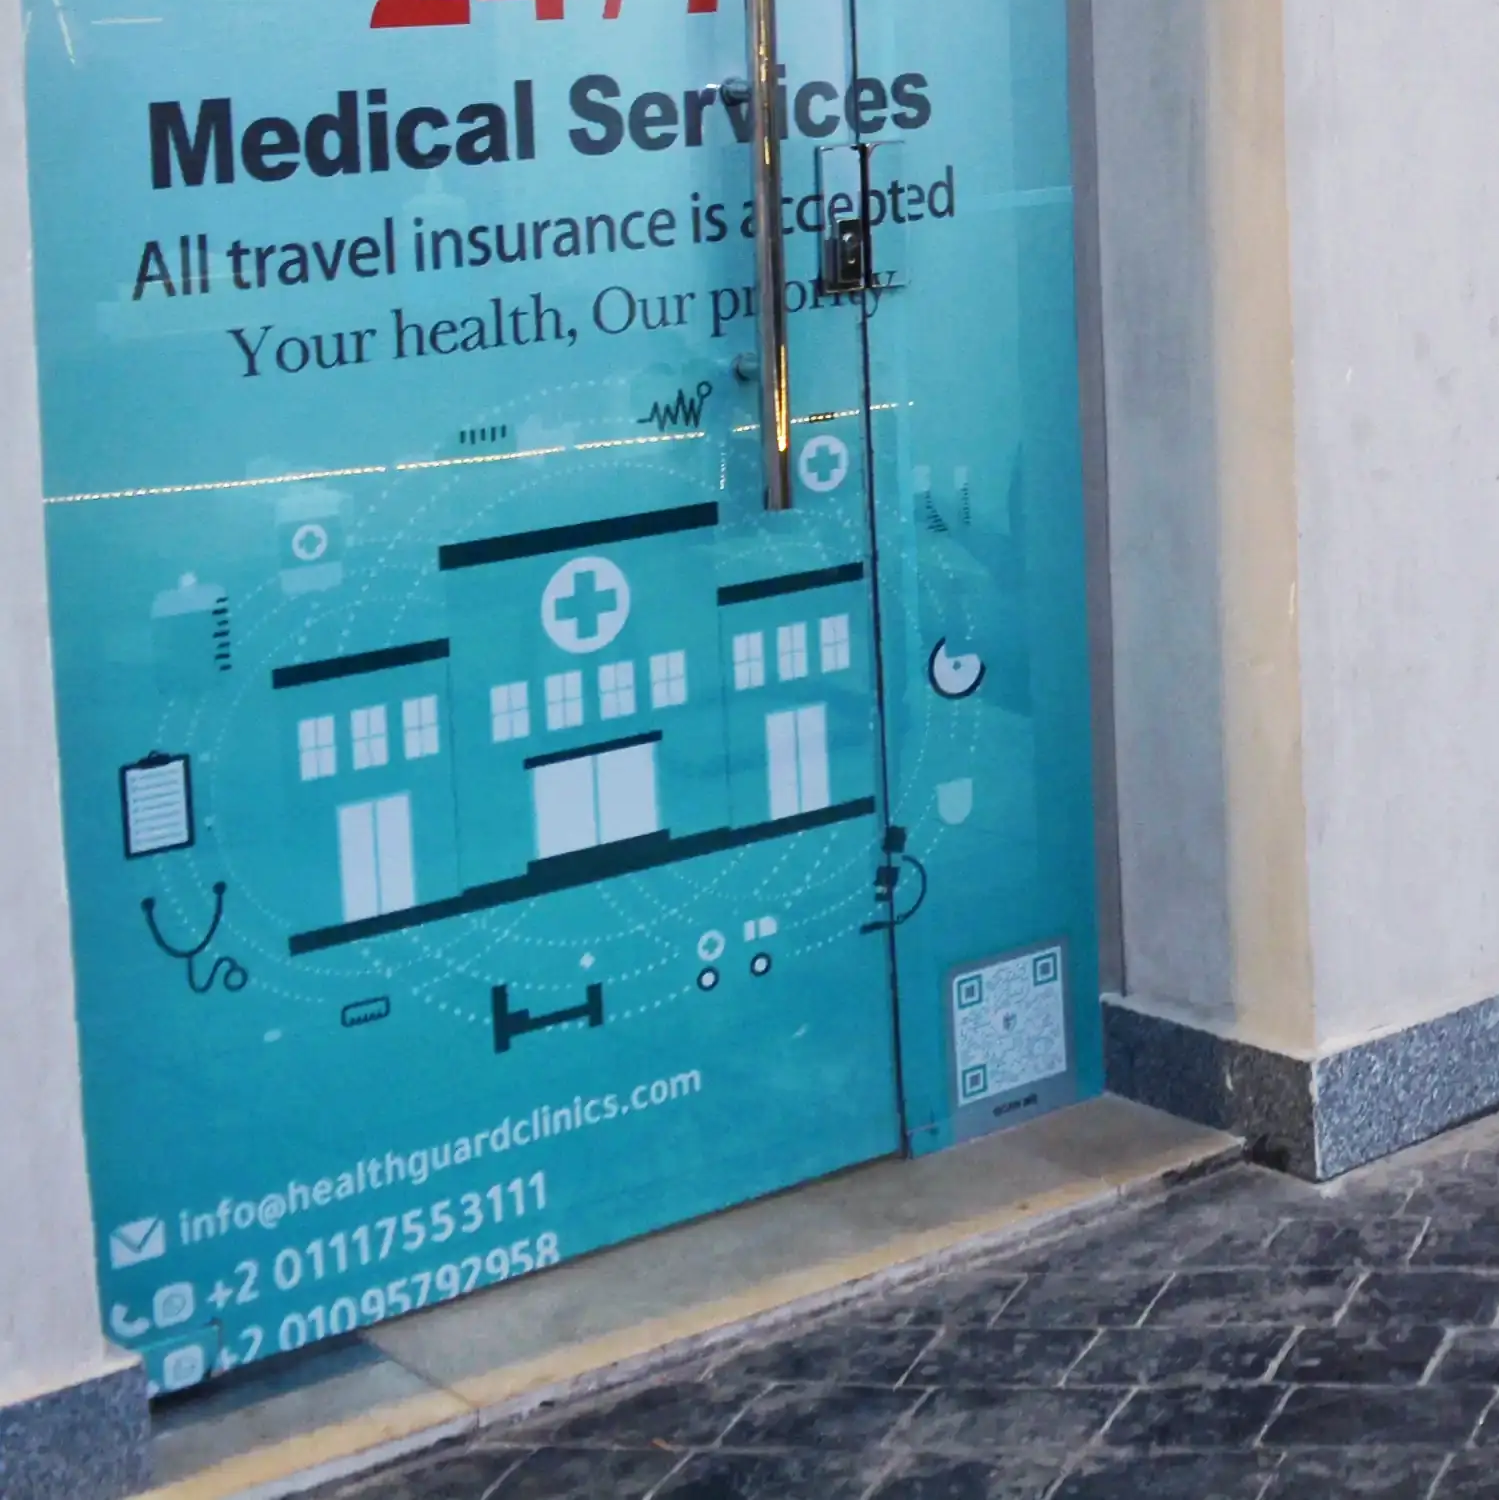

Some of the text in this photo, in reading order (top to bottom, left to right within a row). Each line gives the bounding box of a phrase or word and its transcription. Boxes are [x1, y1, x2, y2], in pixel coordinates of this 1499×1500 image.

[148, 63, 932, 190] Medical Services
[132, 233, 211, 301] All
[227, 216, 395, 291] travel
[414, 206, 676, 273] insurance
[691, 191, 728, 245] is
[227, 325, 377, 378] Your
[391, 292, 579, 348] health,
[591, 279, 696, 336] Our
[179, 1068, 702, 1245] info@healthguardclinics.com
[206, 1171, 548, 1309] +2 01117553111
